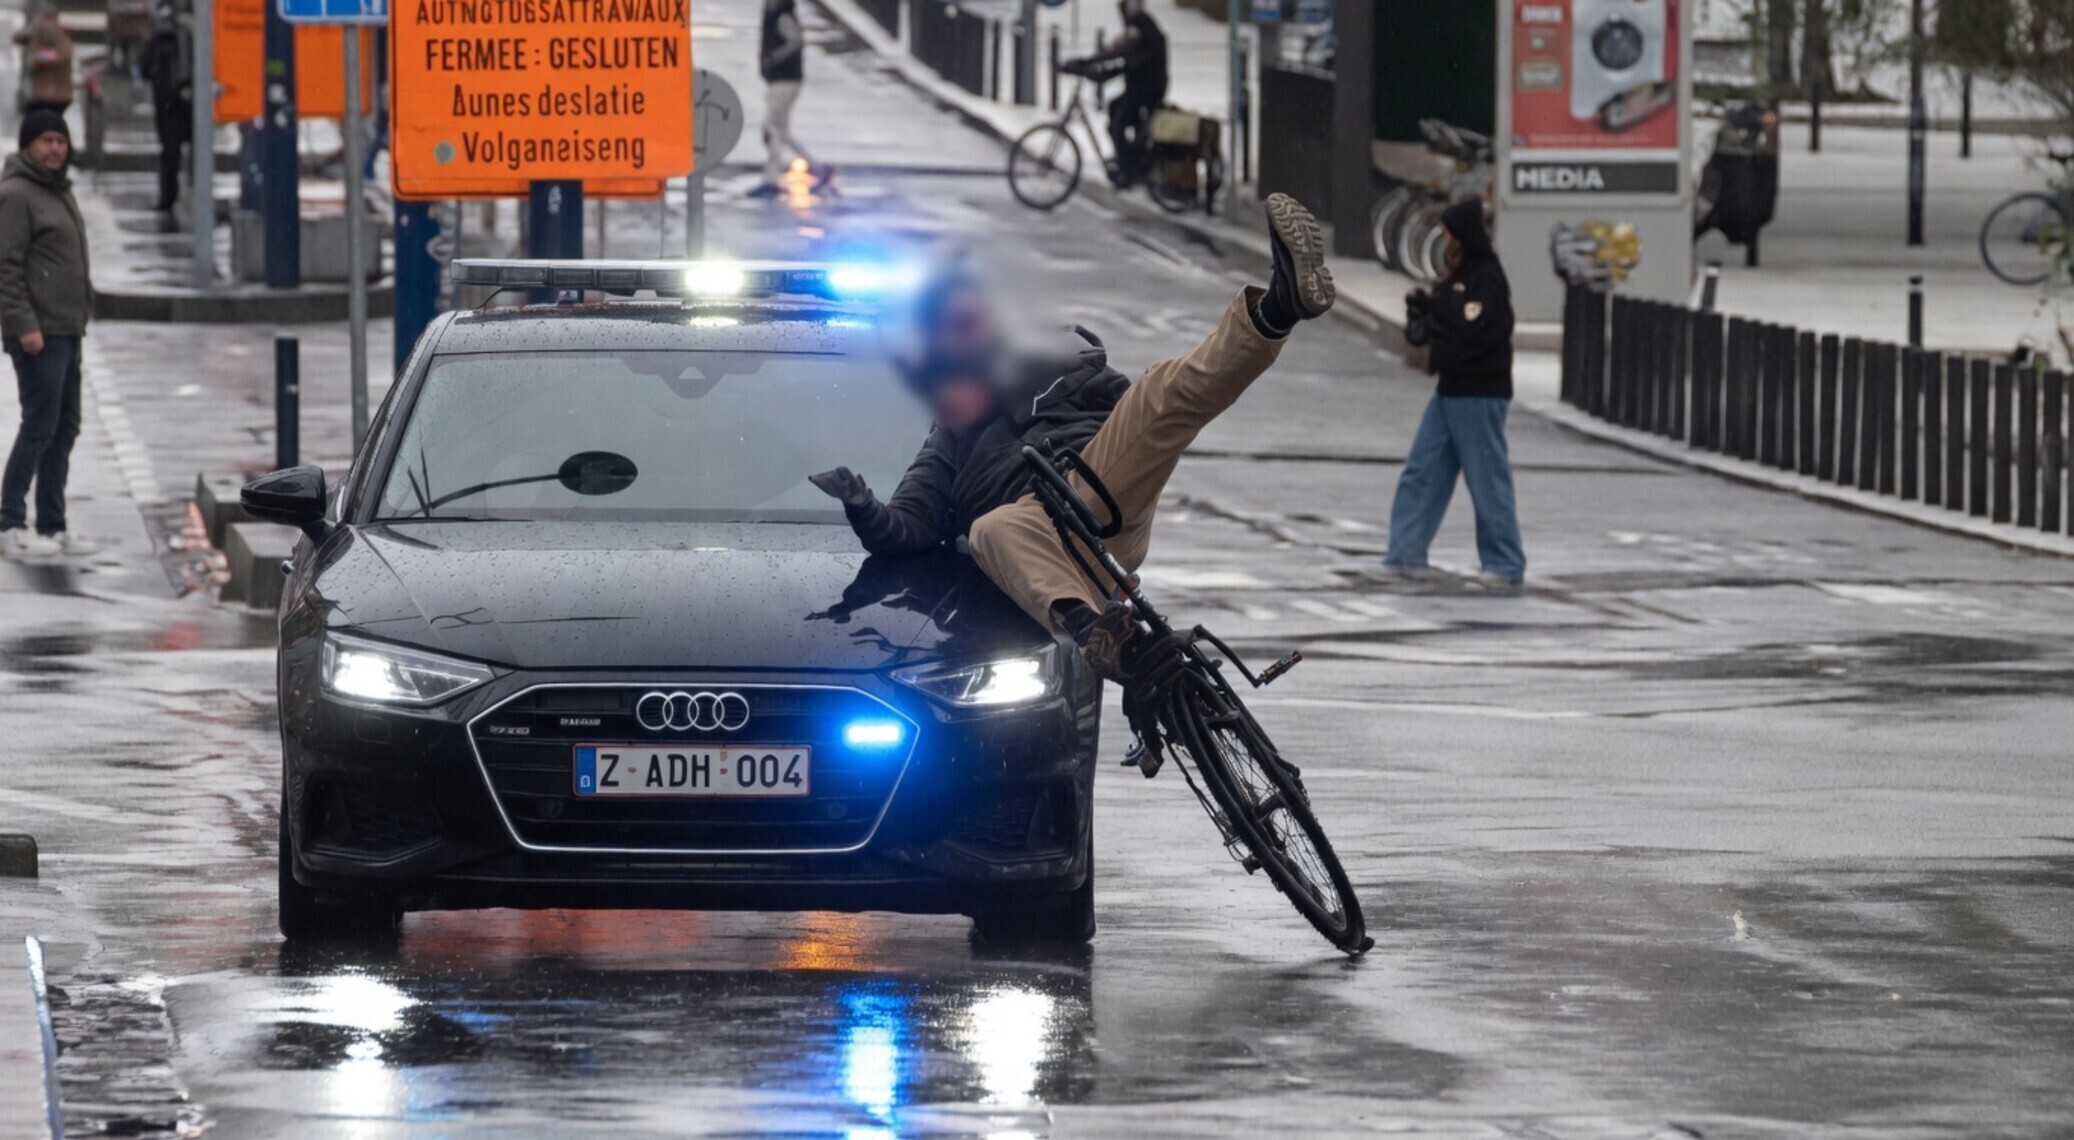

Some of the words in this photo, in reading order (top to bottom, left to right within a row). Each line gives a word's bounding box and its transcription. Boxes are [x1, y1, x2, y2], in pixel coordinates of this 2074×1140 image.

[425, 38, 527, 72] FERMEE
[549, 36, 679, 70] GESLUTEN
[537, 83, 645, 117] deslatie
[1516, 167, 1604, 189] MEDIA
[600, 753, 620, 788] Z
[645, 753, 711, 788] ADH
[736, 753, 803, 788] 004
